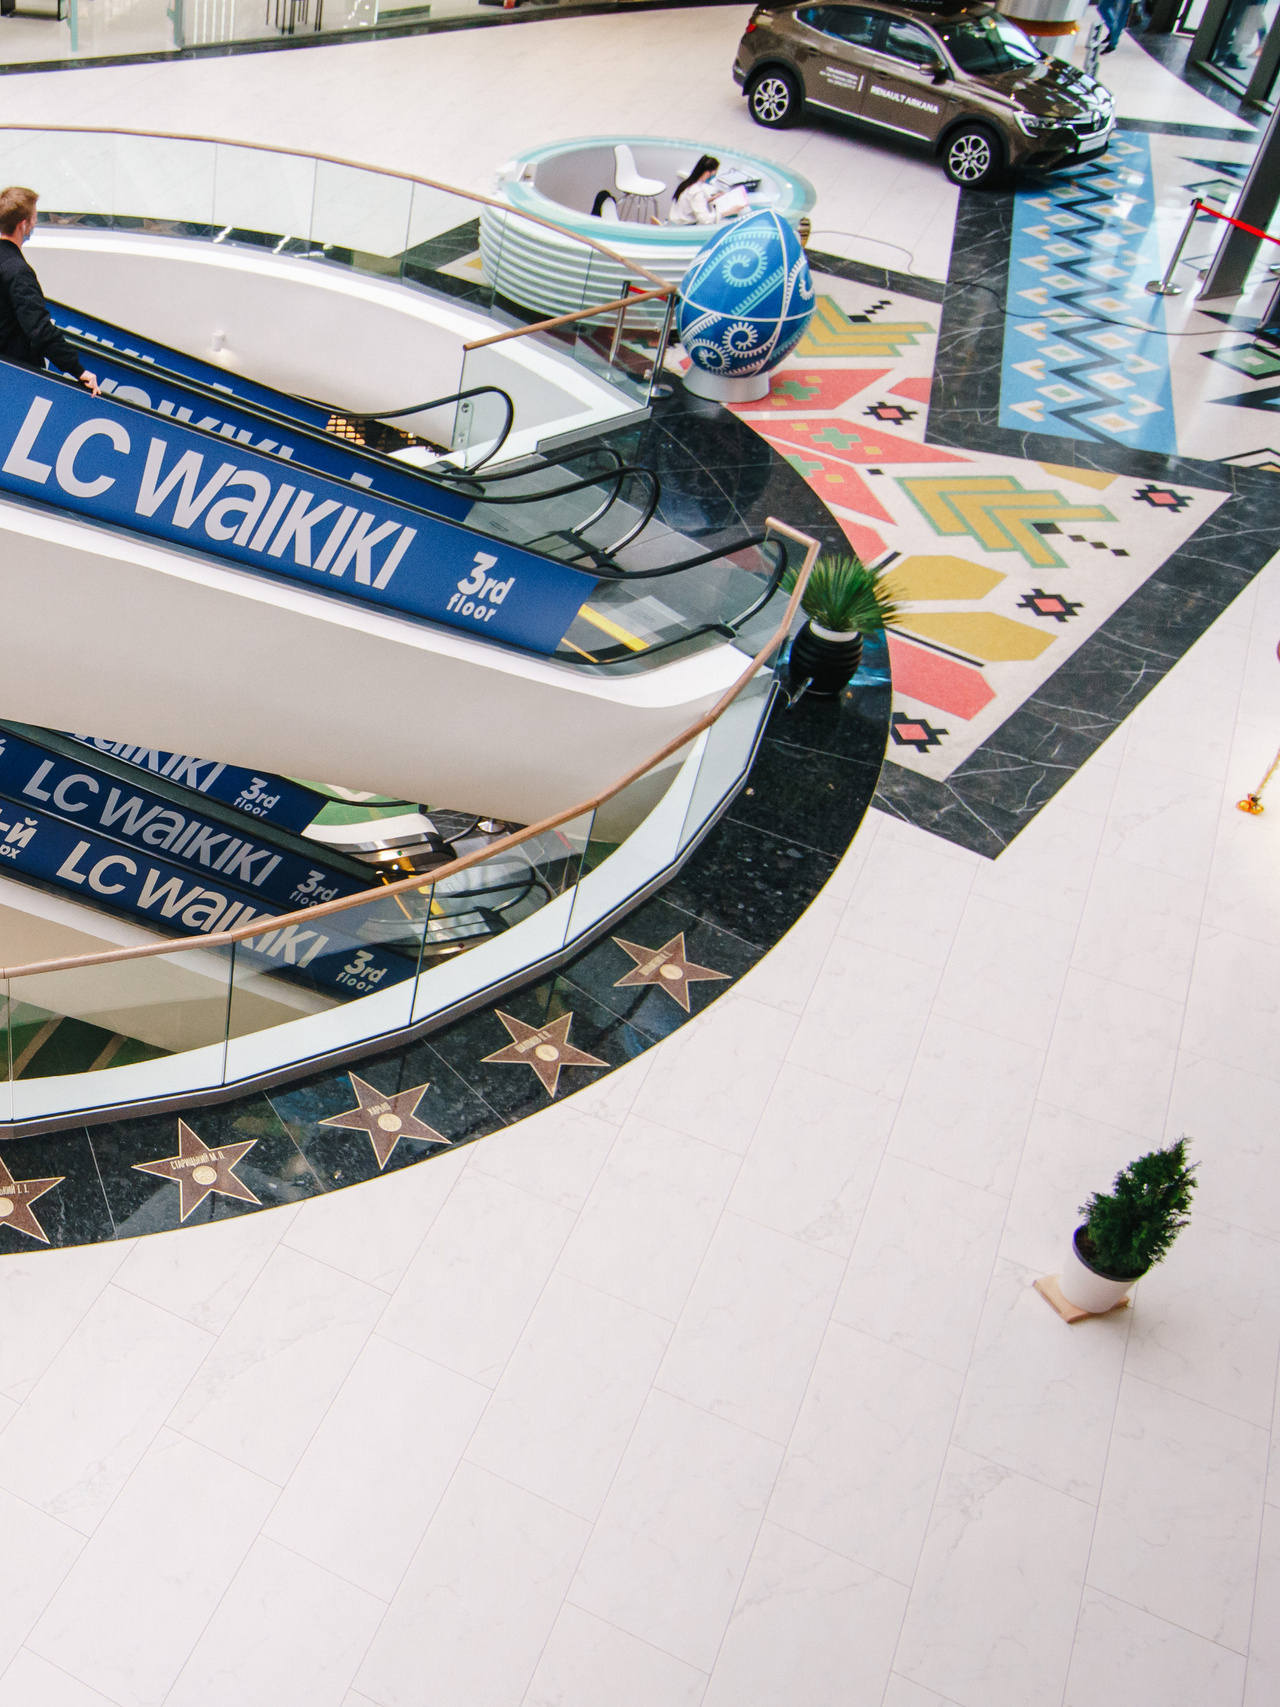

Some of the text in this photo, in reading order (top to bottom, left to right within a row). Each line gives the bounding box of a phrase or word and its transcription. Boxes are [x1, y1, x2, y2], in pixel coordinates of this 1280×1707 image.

[870, 85, 939, 114] RENAULT ARKANA
[2, 395, 131, 498] LC
[457, 551, 515, 606] 3rd
[446, 593, 498, 622] floor
[21, 759, 100, 813] LC
[239, 776, 281, 809] 3rd
[233, 797, 269, 818] floor
[55, 840, 138, 895] LC
[296, 869, 339, 902] 3rd
[335, 971, 374, 992] floor
[344, 949, 388, 984] 3rd
